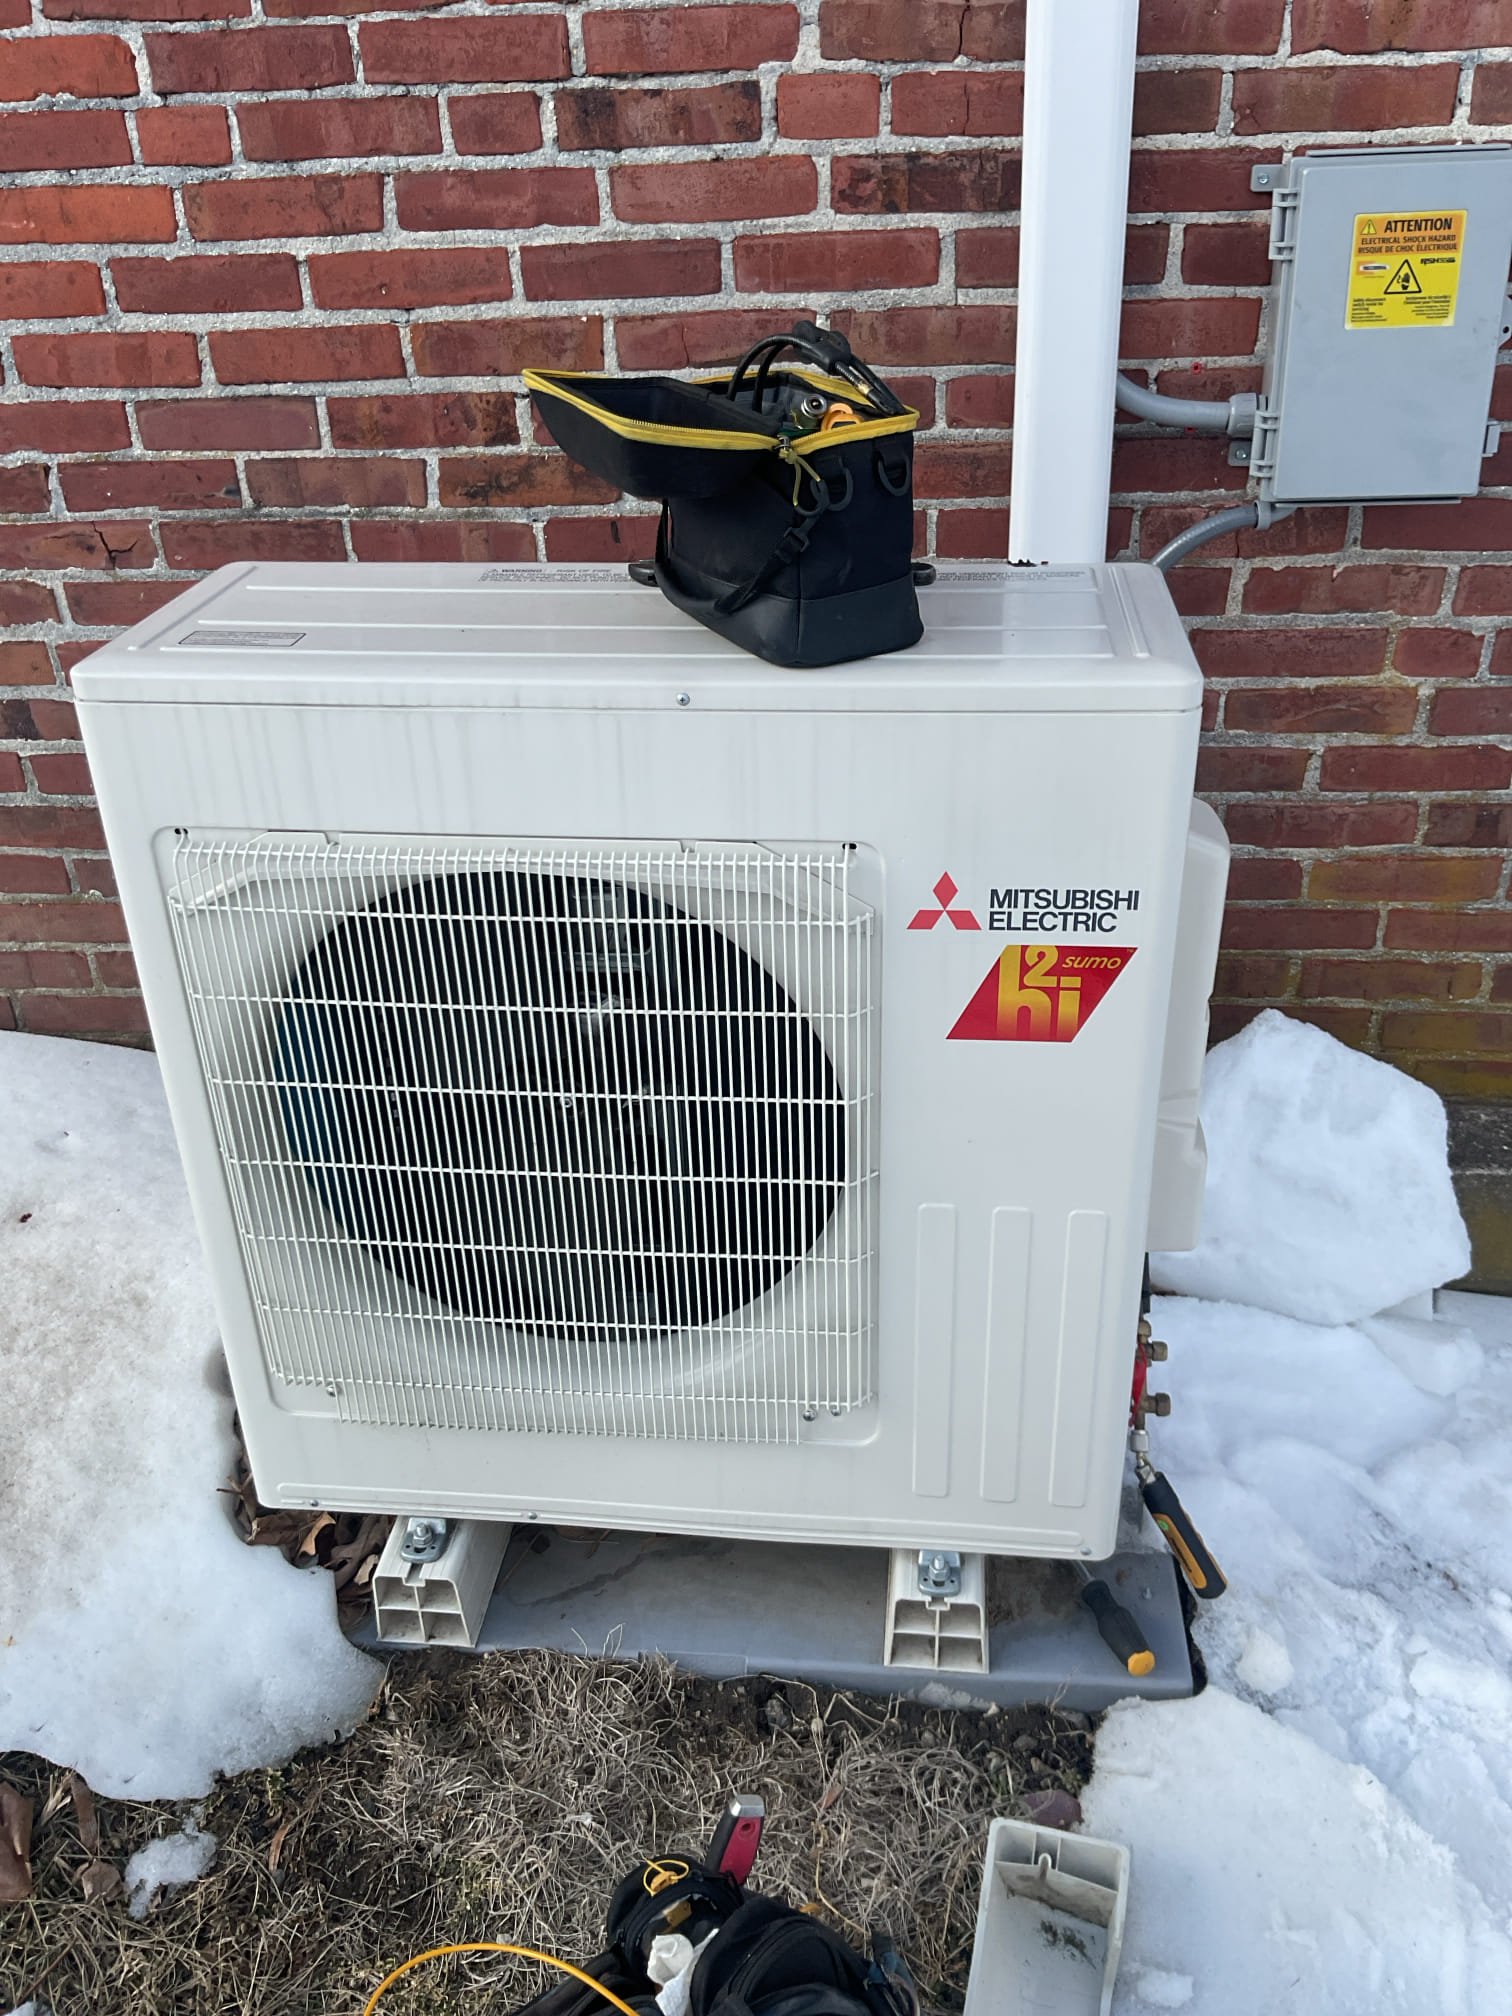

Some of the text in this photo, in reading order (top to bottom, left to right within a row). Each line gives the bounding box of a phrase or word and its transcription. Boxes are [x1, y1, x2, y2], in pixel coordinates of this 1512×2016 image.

[1384, 218, 1452, 233] ATTENTION
[1361, 234, 1456, 245] ELECTRICAL SHOCK HAZARD
[1358, 246, 1383, 254] RISQUE
[1385, 245, 1395, 253] DE
[1395, 245, 1416, 253] CHOC
[989, 888, 1139, 911] MITSUBISHI
[988, 911, 1118, 933] ELECTRIC
[1062, 954, 1121, 970] sumo
